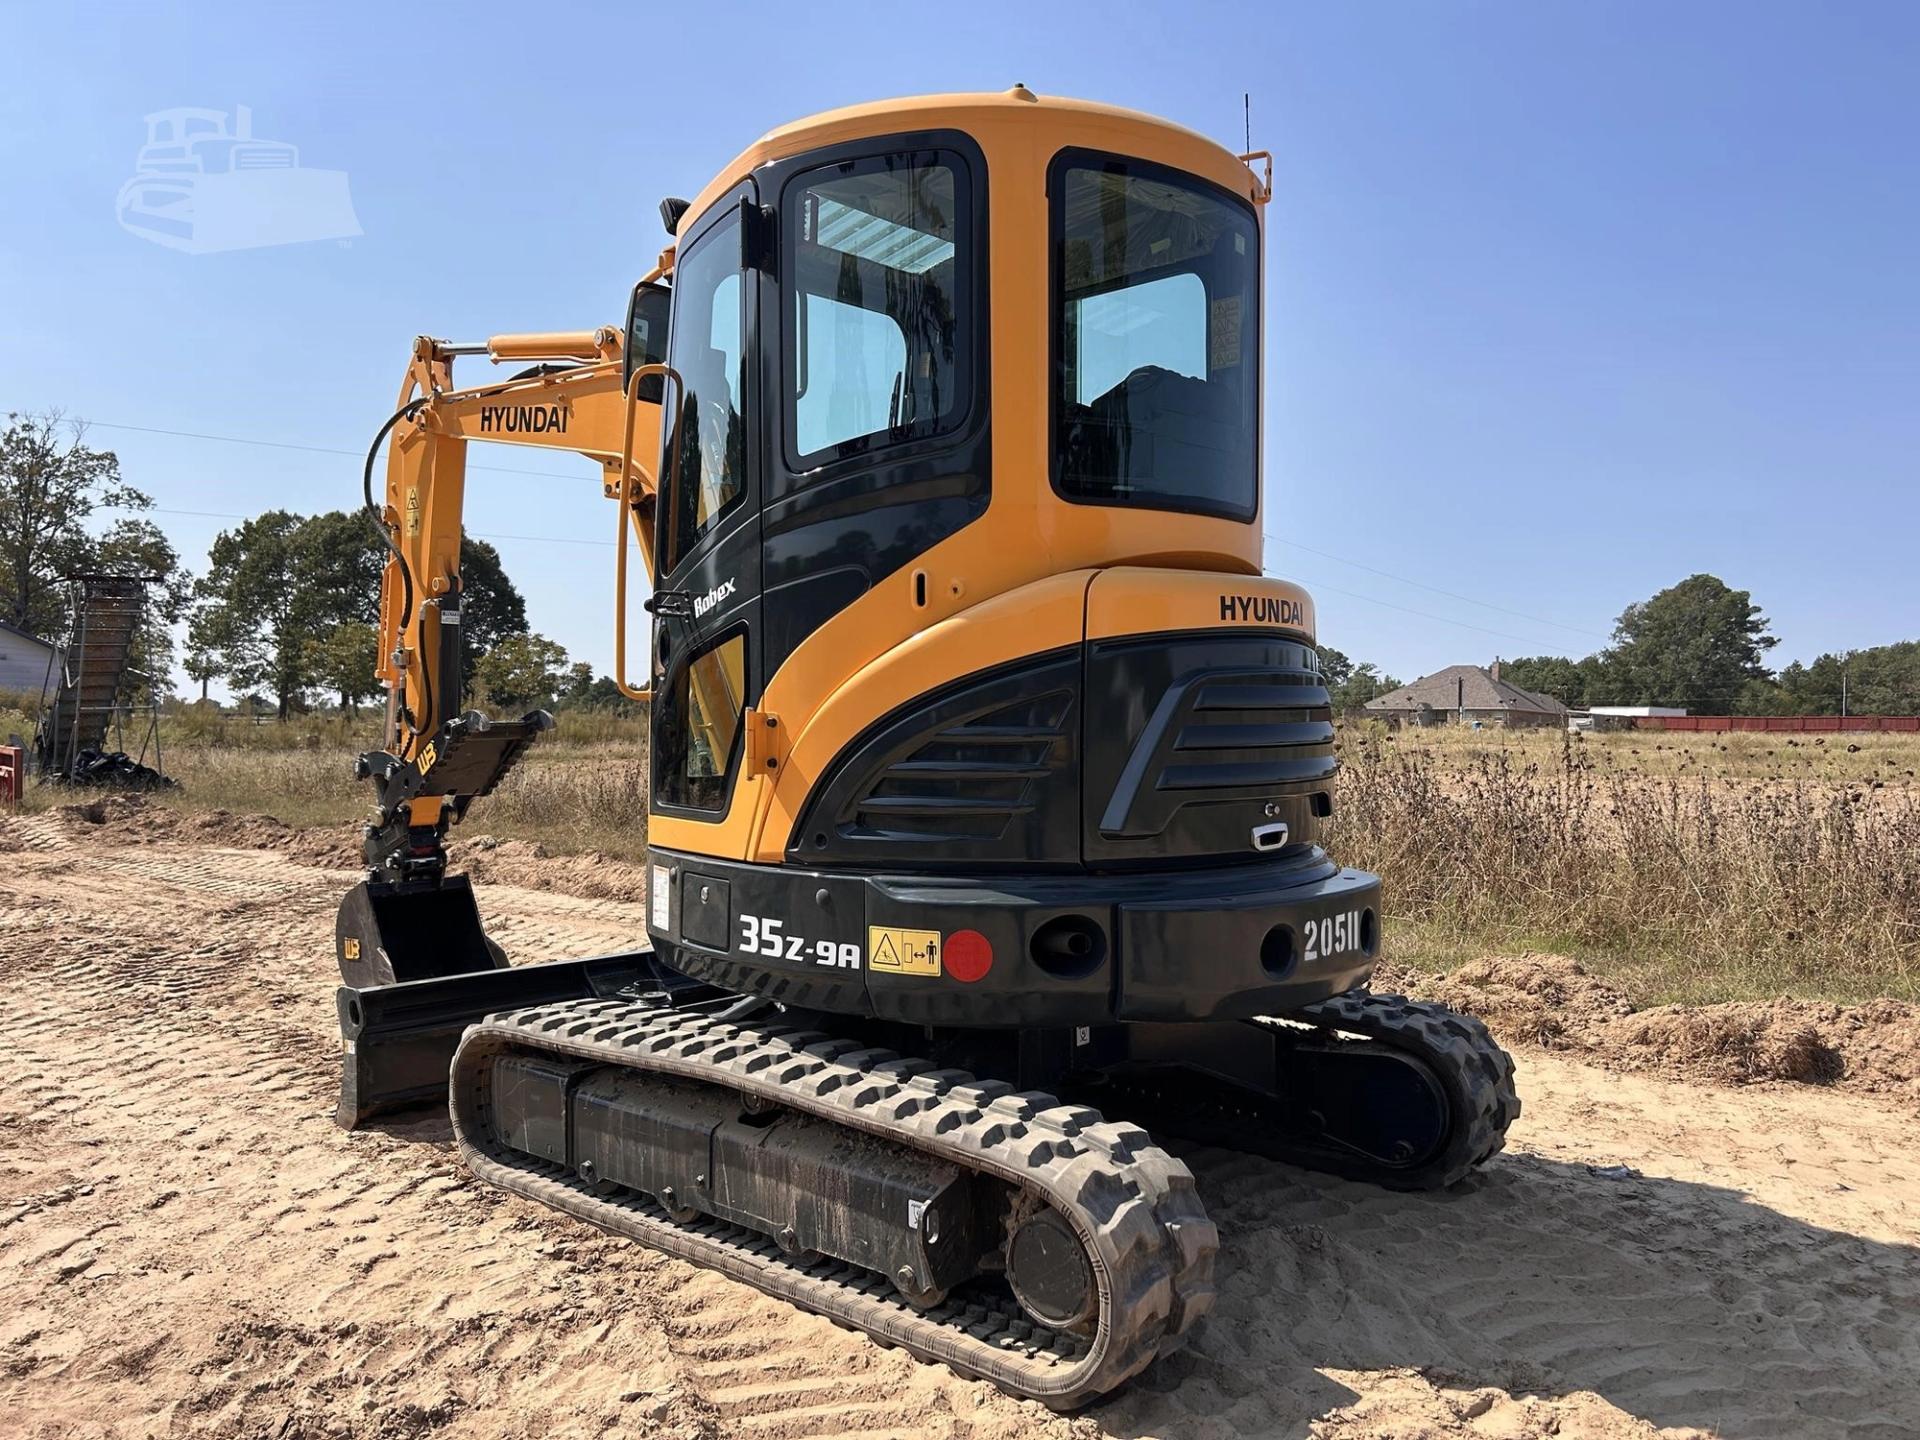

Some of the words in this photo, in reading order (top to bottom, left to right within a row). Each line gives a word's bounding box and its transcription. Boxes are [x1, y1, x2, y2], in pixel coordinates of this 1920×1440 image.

[480, 406, 569, 433] HYUNDAI
[693, 577, 737, 619] Robex
[1220, 595, 1304, 626] HYUNDAI
